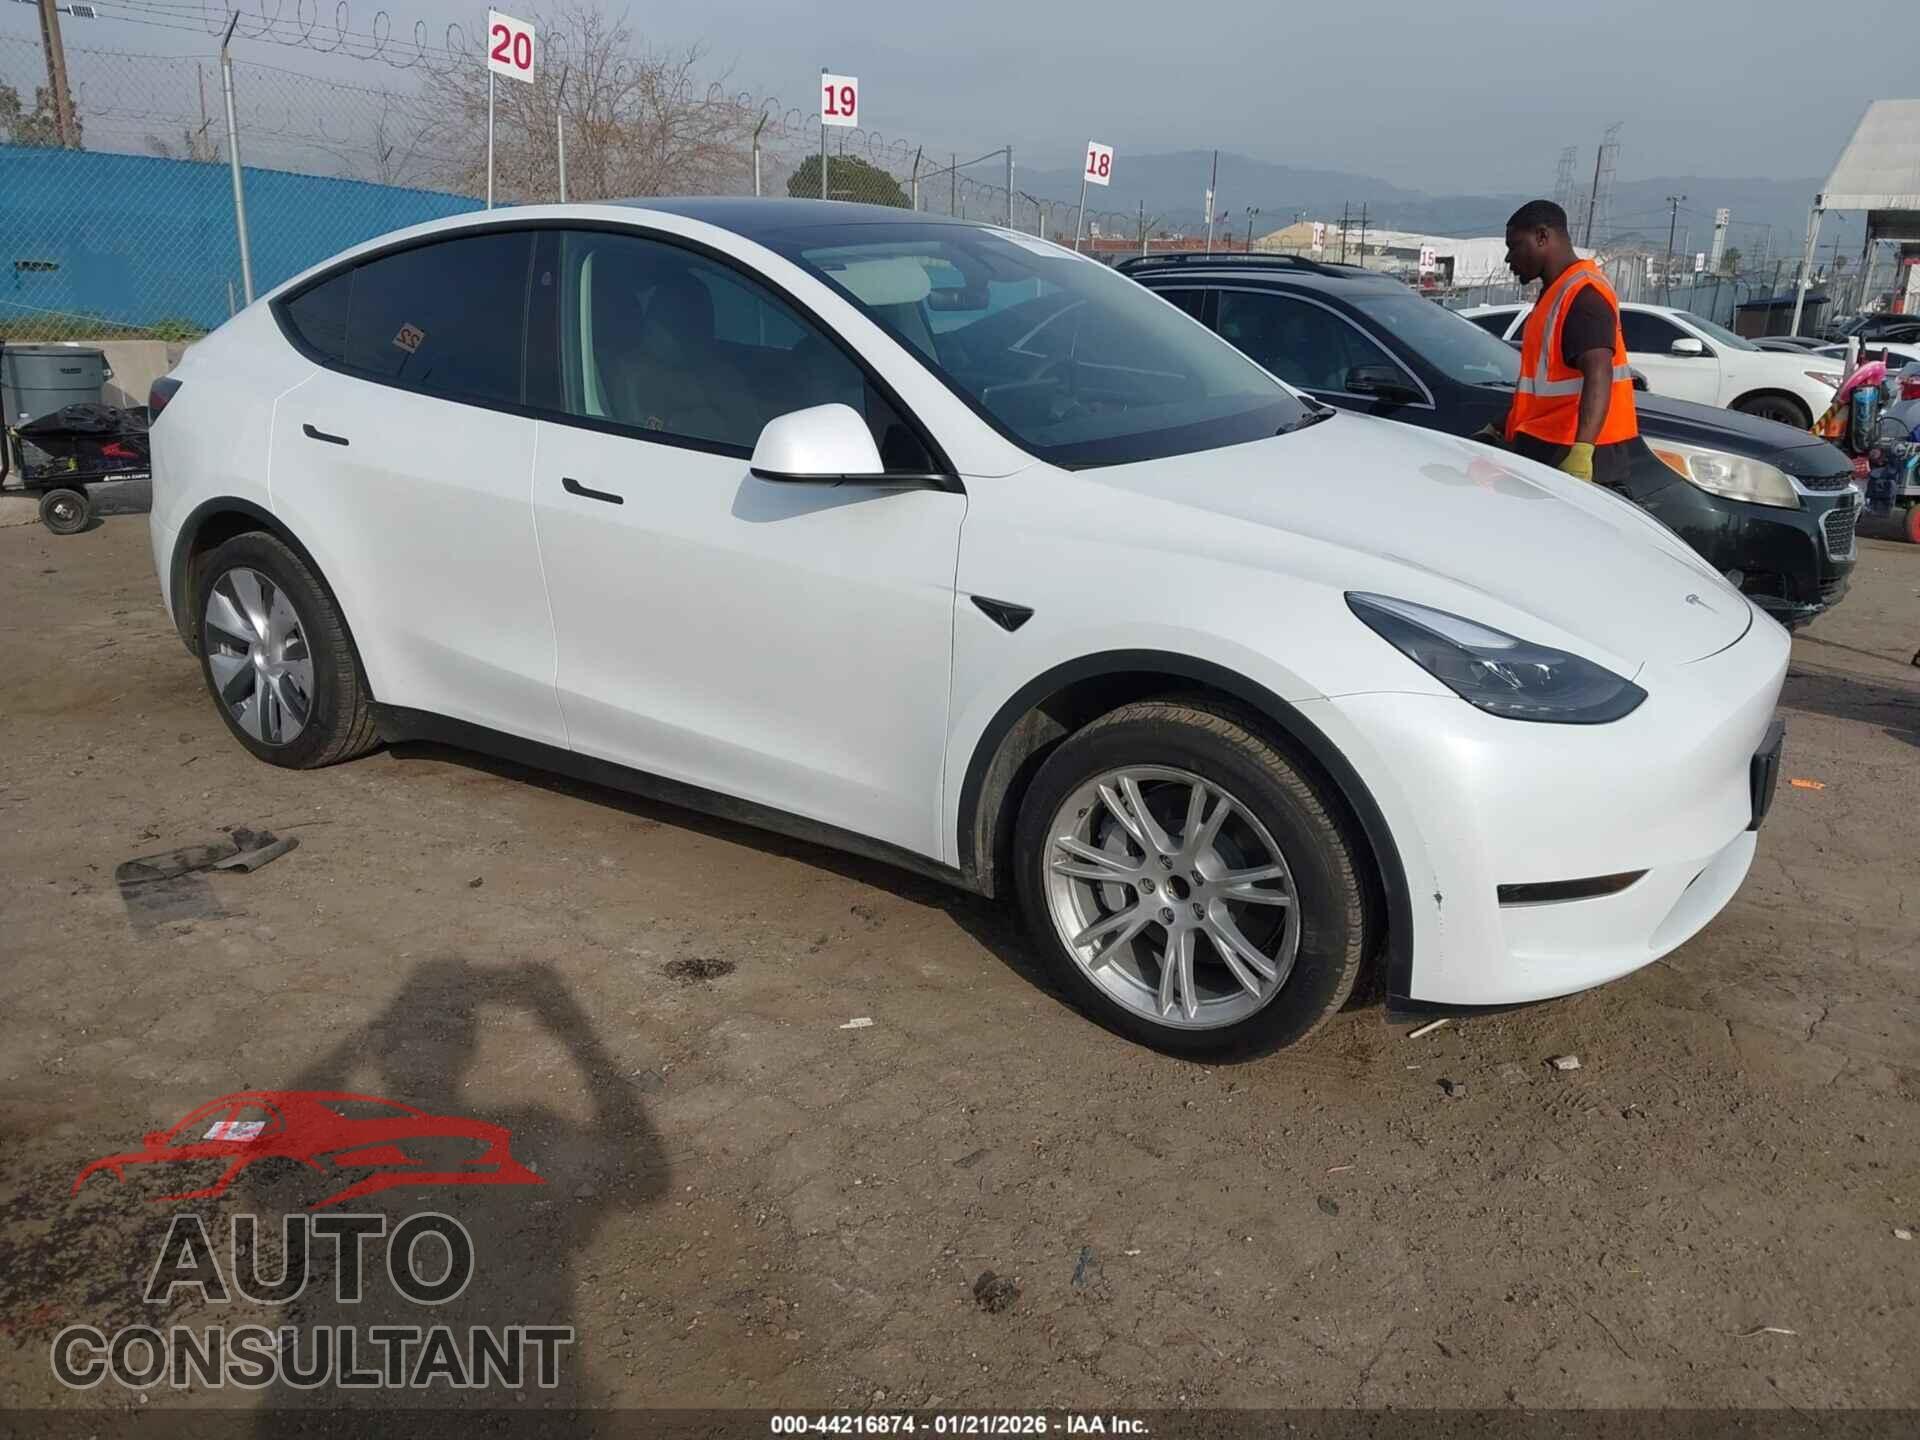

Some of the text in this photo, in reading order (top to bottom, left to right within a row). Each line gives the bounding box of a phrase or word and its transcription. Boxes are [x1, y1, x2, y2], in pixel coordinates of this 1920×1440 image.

[491, 24, 532, 70] 20
[824, 85, 856, 117] 19
[1087, 151, 1110, 177] 18
[1420, 251, 1434, 267] 15
